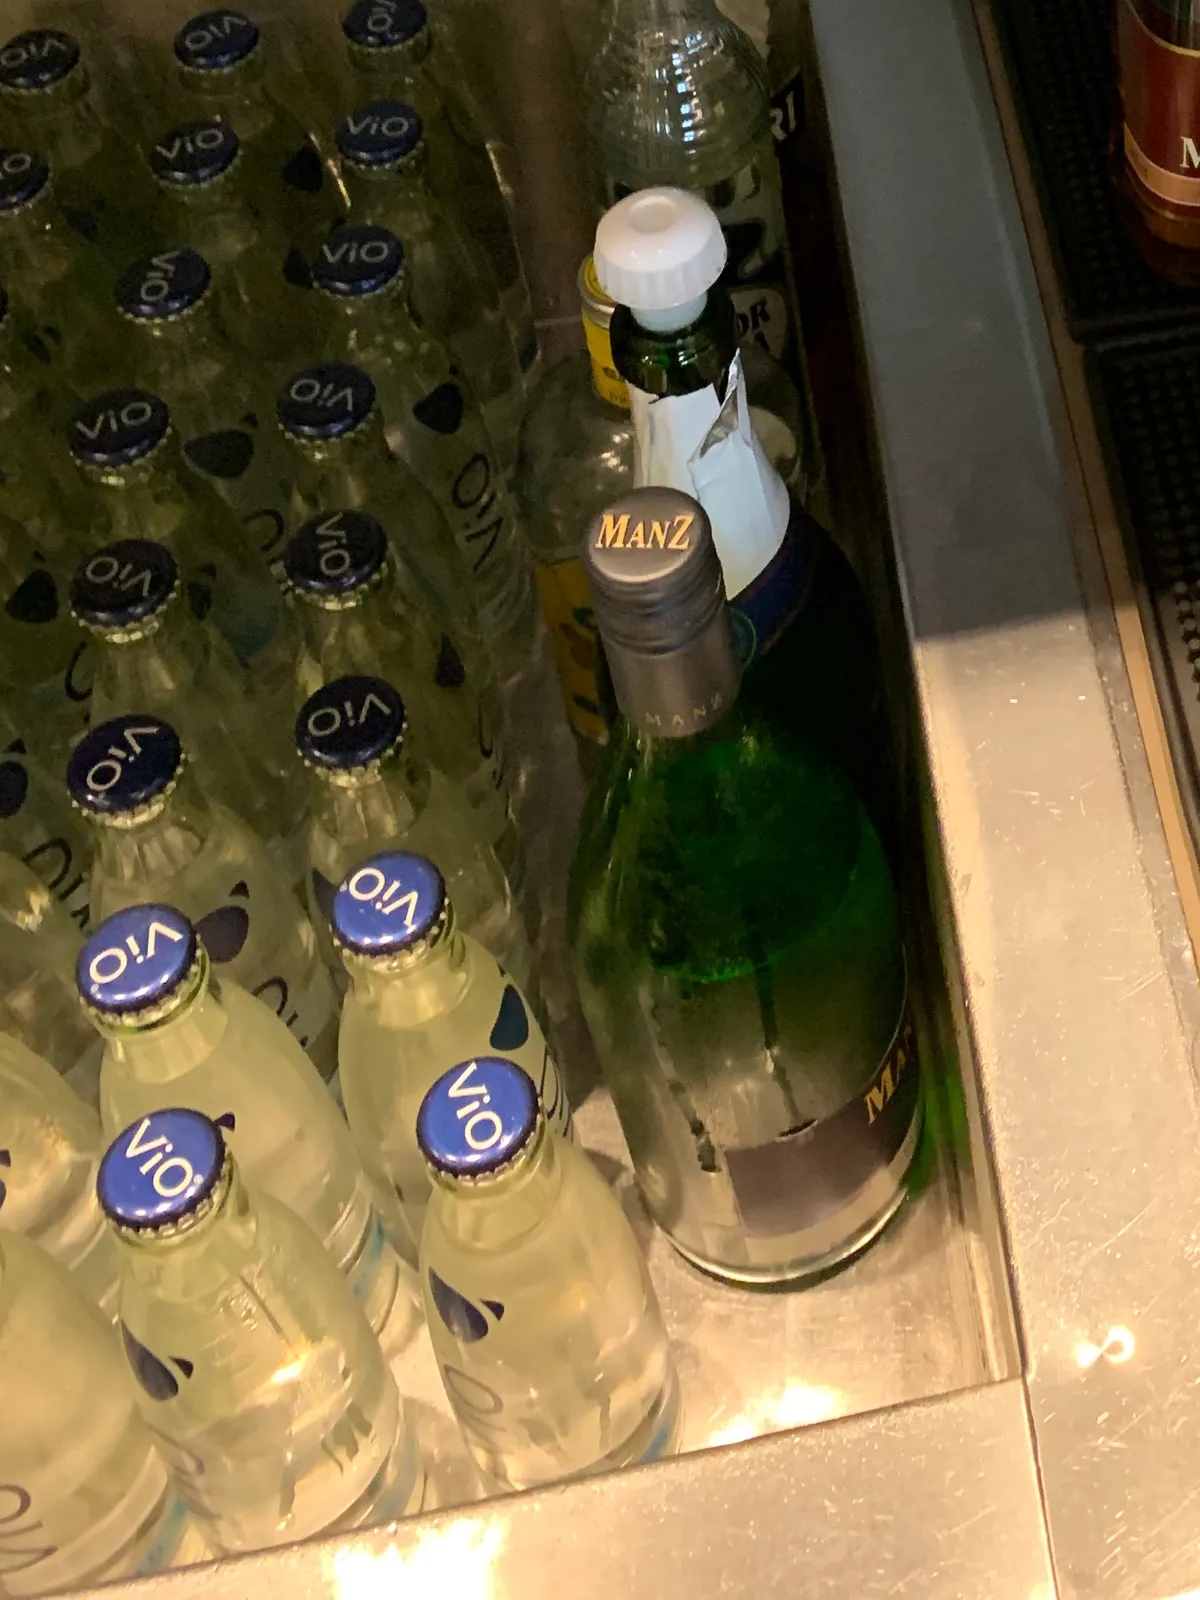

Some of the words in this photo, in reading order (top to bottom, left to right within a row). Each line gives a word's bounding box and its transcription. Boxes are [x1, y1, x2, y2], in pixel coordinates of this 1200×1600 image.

[595, 513, 696, 550] MANZ
[348, 865, 422, 928] ViO
[88, 920, 183, 986] ViO
[446, 1061, 502, 1152] ViO
[124, 1118, 195, 1198] ViO
